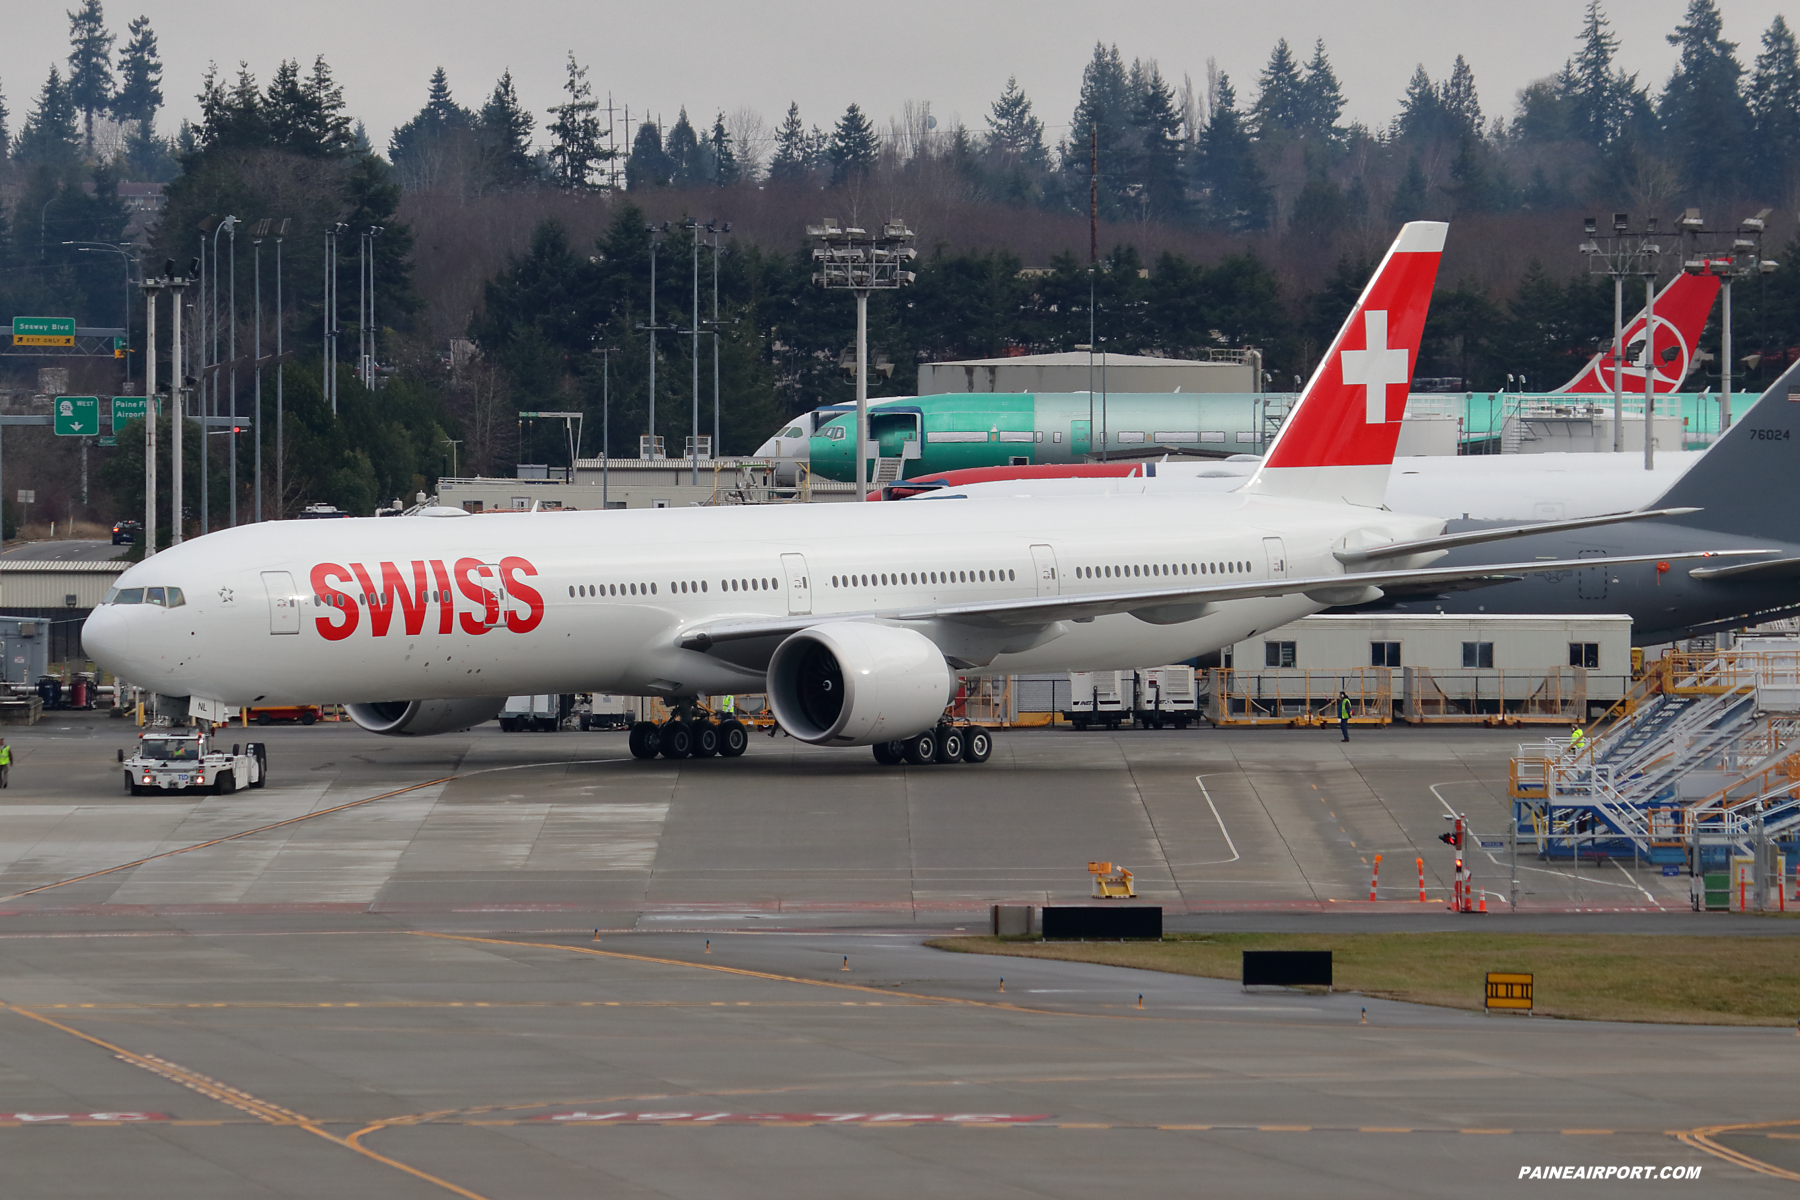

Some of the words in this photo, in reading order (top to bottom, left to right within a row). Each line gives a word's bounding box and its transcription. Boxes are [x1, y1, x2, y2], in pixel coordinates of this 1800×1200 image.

[19, 323, 48, 331] Seaway
[51, 323, 69, 331] Blvd
[115, 400, 137, 408] Paine
[116, 410, 145, 418] Airport
[1750, 429, 1790, 441] 76024
[310, 556, 545, 642] SWISS
[198, 702, 207, 712] NL
